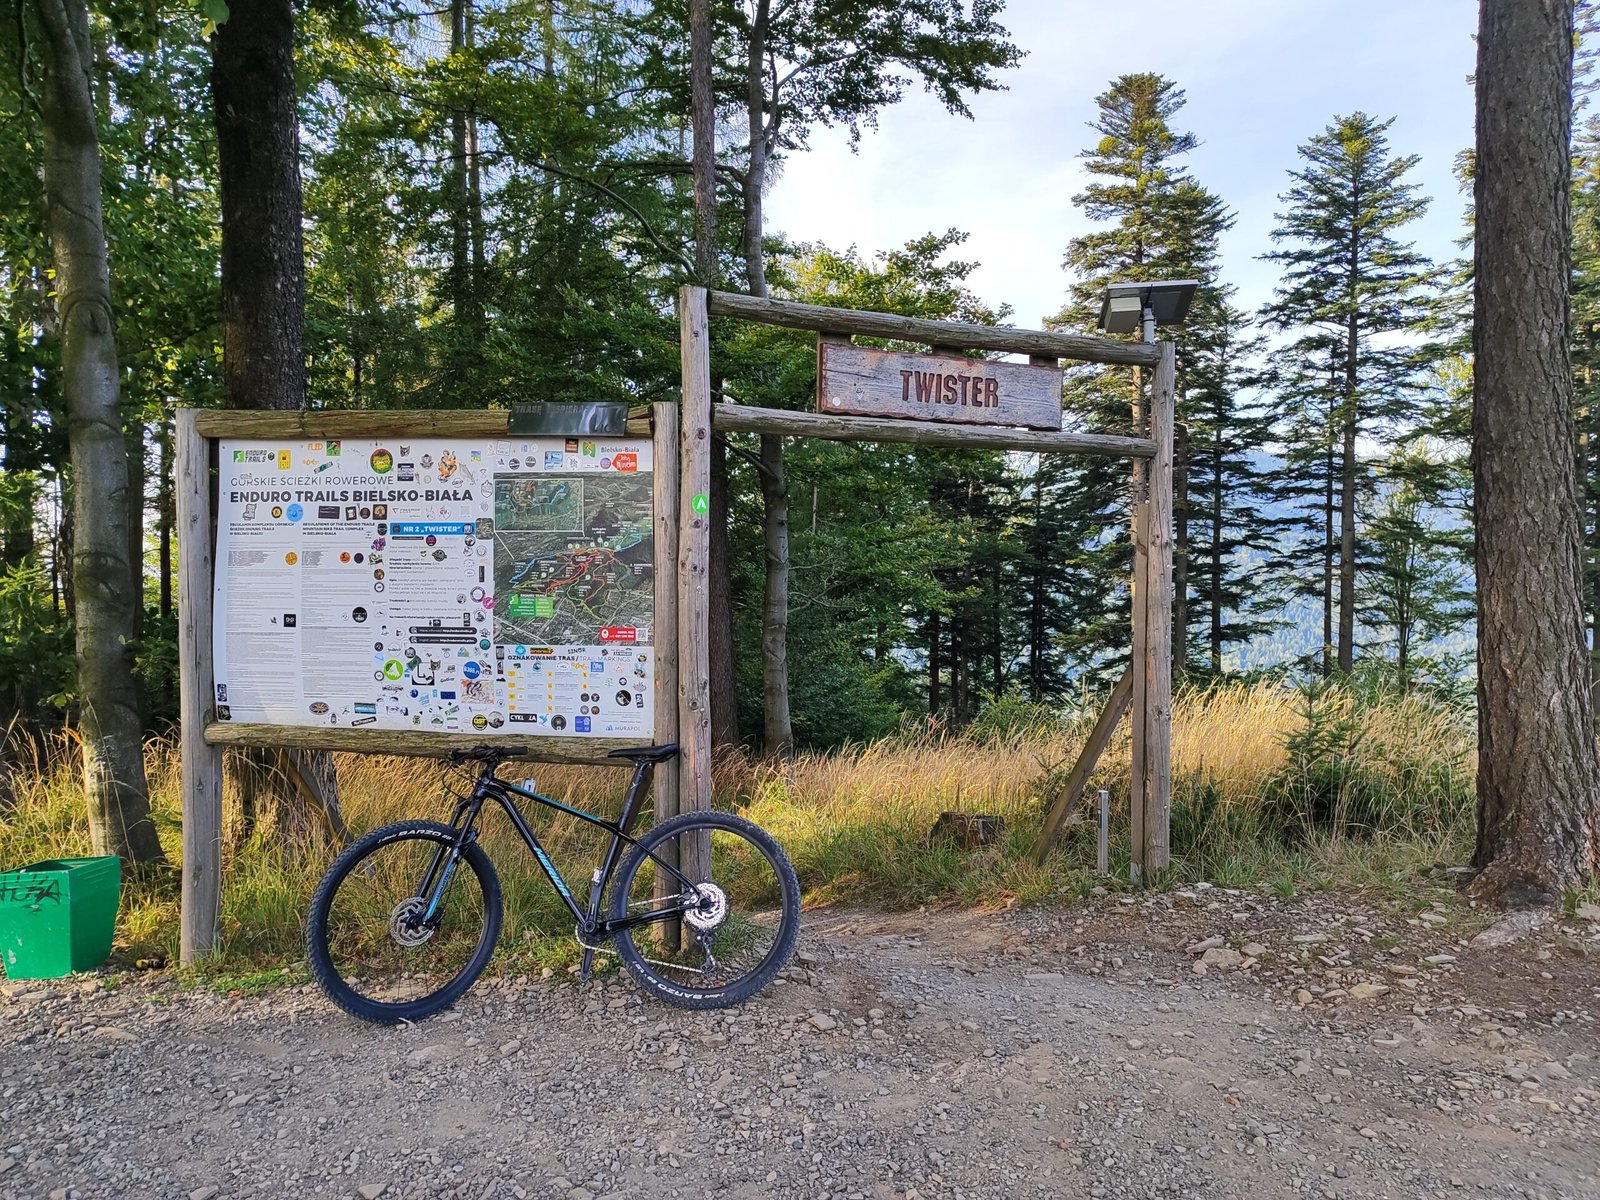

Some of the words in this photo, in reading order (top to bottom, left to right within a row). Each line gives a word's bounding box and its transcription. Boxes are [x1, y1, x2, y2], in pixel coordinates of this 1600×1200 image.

[900, 370, 999, 408] TWISTER
[280, 474, 322, 486] ŚCIEŻKI
[325, 476, 394, 486] ROWEROWE
[230, 491, 292, 503] ENDURO
[295, 490, 349, 502] TRAILS
[353, 489, 473, 502] BIELSKO-BIAŁA
[398, 829, 442, 837] BARZO
[534, 847, 570, 898] MERIDA
[657, 983, 703, 1000] BARZO
